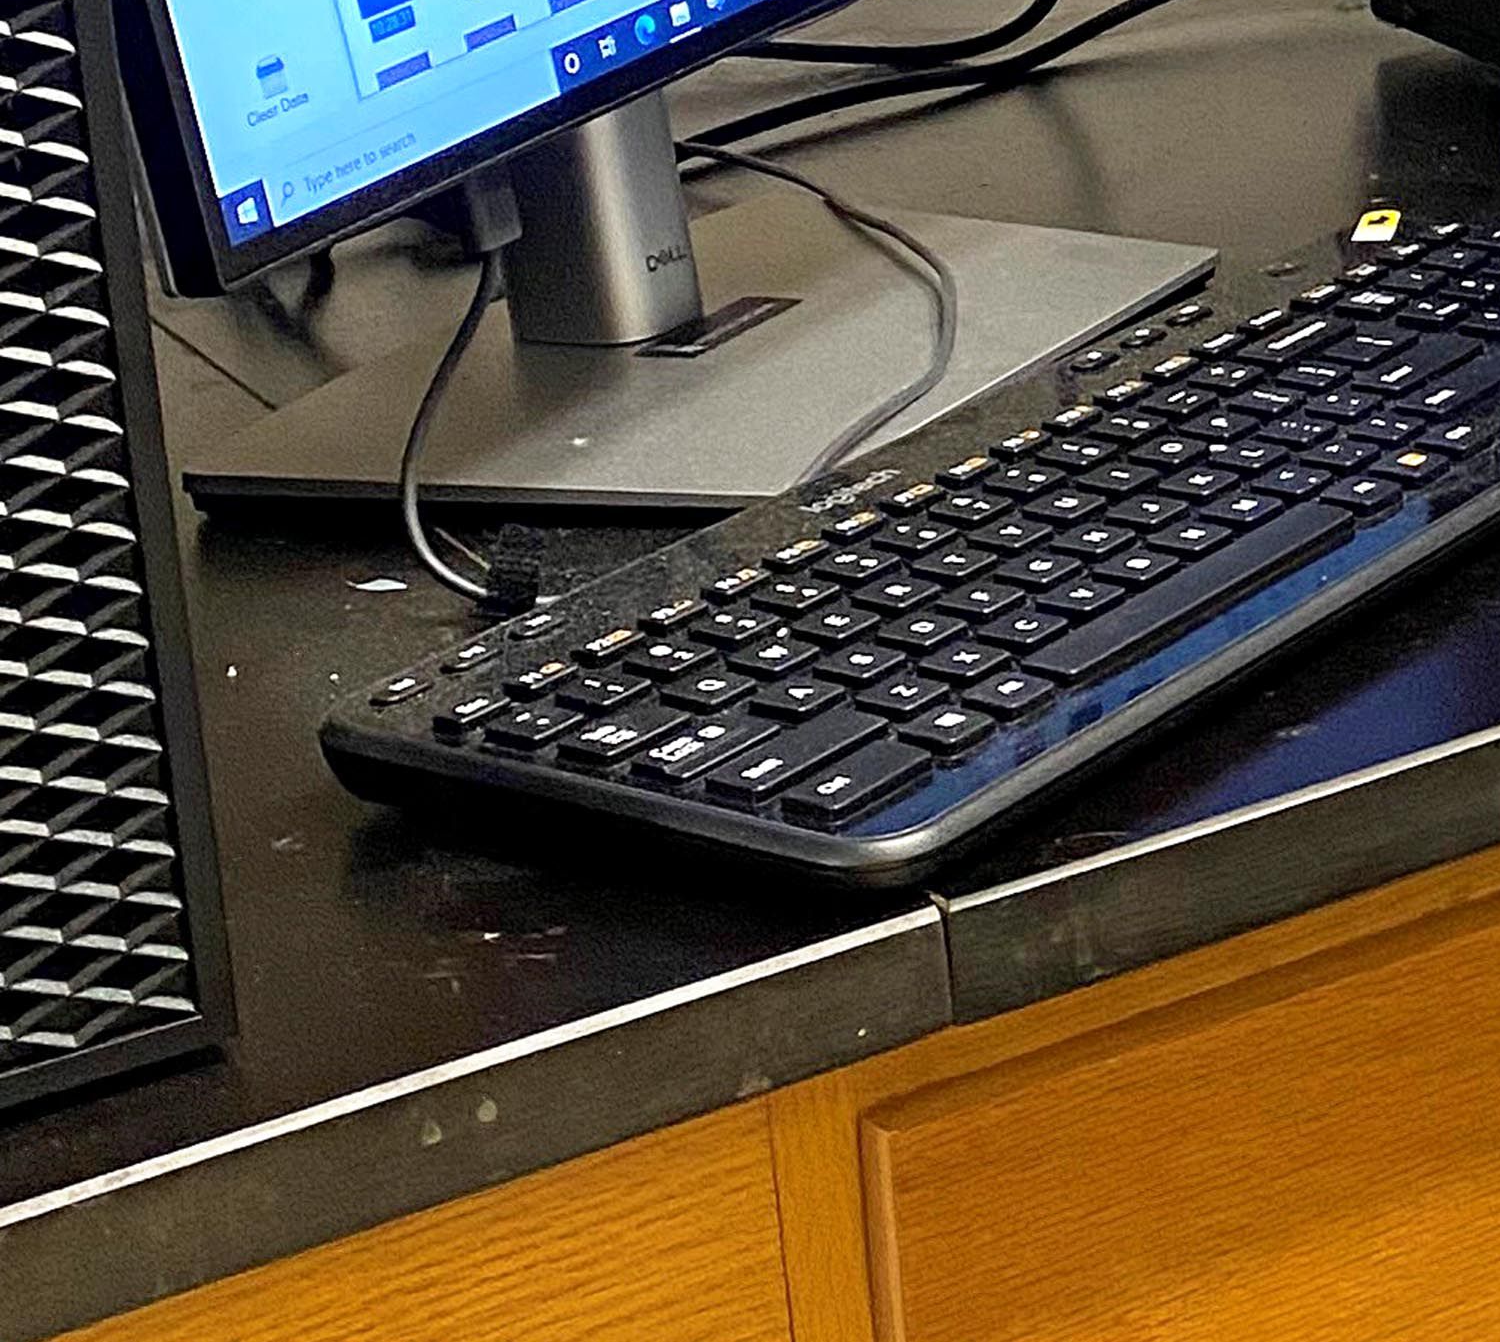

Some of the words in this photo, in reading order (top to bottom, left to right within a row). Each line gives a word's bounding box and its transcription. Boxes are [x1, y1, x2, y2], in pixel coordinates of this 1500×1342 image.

[304, 170, 333, 196] Type
[334, 158, 361, 179] here
[363, 150, 377, 166] to
[379, 132, 416, 159] search
[646, 244, 688, 274] DELL
